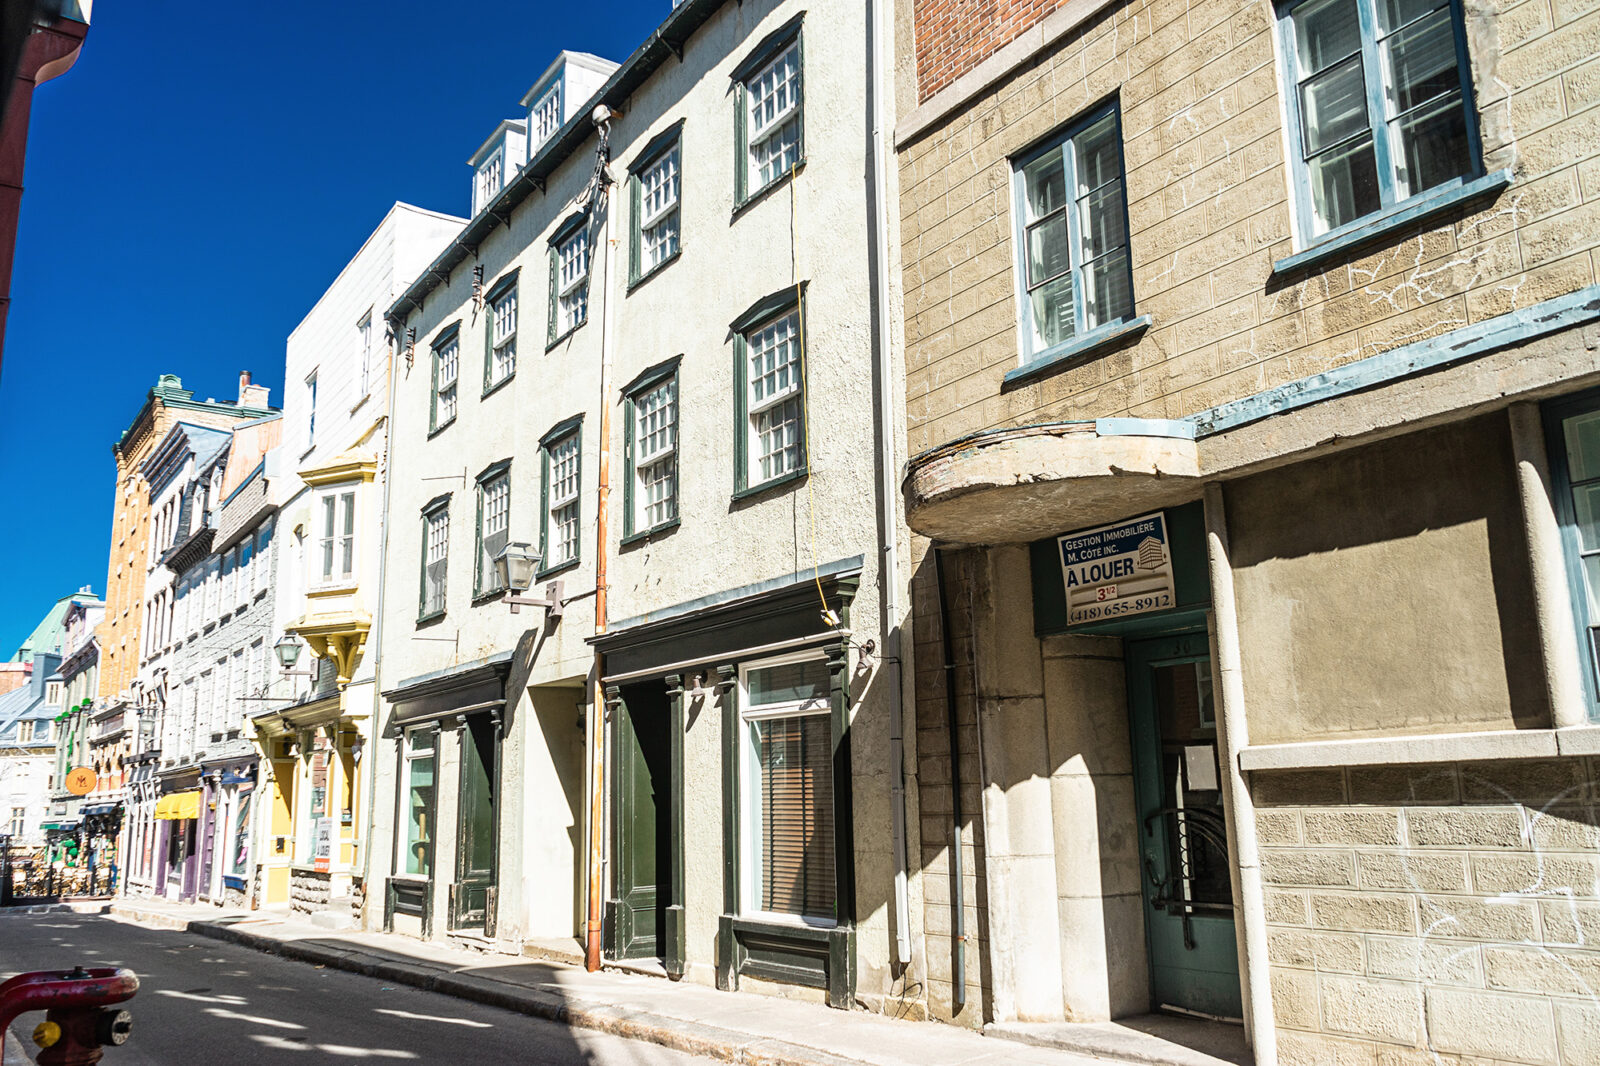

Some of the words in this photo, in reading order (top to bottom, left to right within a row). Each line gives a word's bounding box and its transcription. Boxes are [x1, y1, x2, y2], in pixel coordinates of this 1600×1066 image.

[1065, 535, 1101, 551] GESTION
[1067, 552, 1079, 563] M.
[1080, 546, 1102, 560] CÔTÉ
[1104, 544, 1119, 555] INC.
[1067, 568, 1079, 587] À
[1081, 557, 1134, 584] LOUER
[1070, 607, 1102, 622] (418)
[1104, 595, 1170, 616] 655-8912
